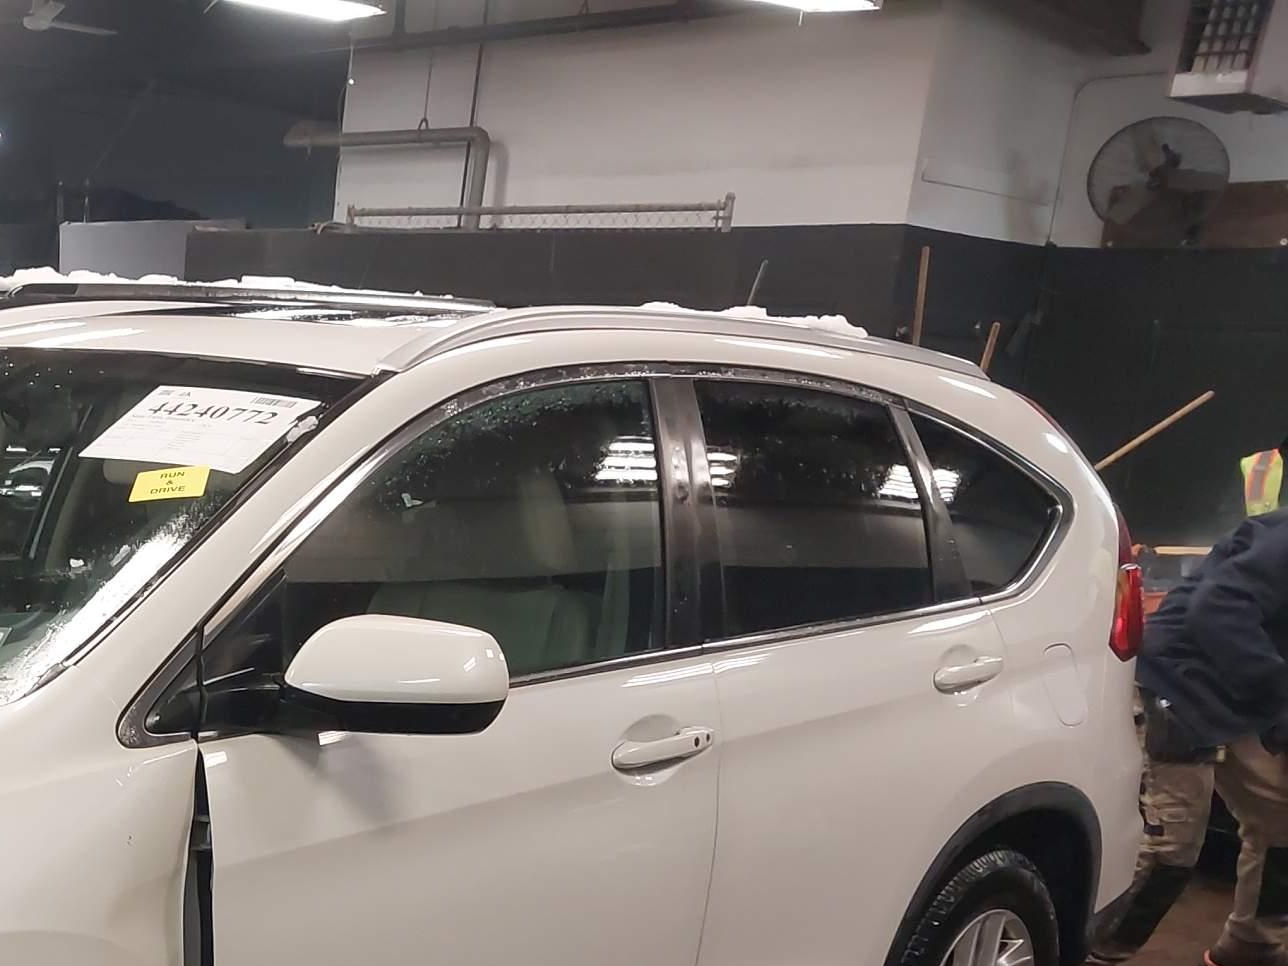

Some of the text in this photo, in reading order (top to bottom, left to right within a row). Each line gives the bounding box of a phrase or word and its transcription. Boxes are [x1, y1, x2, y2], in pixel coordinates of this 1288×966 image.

[148, 401, 278, 425] 44240772
[159, 471, 185, 479] RUN
[150, 485, 186, 495] DRIVE
